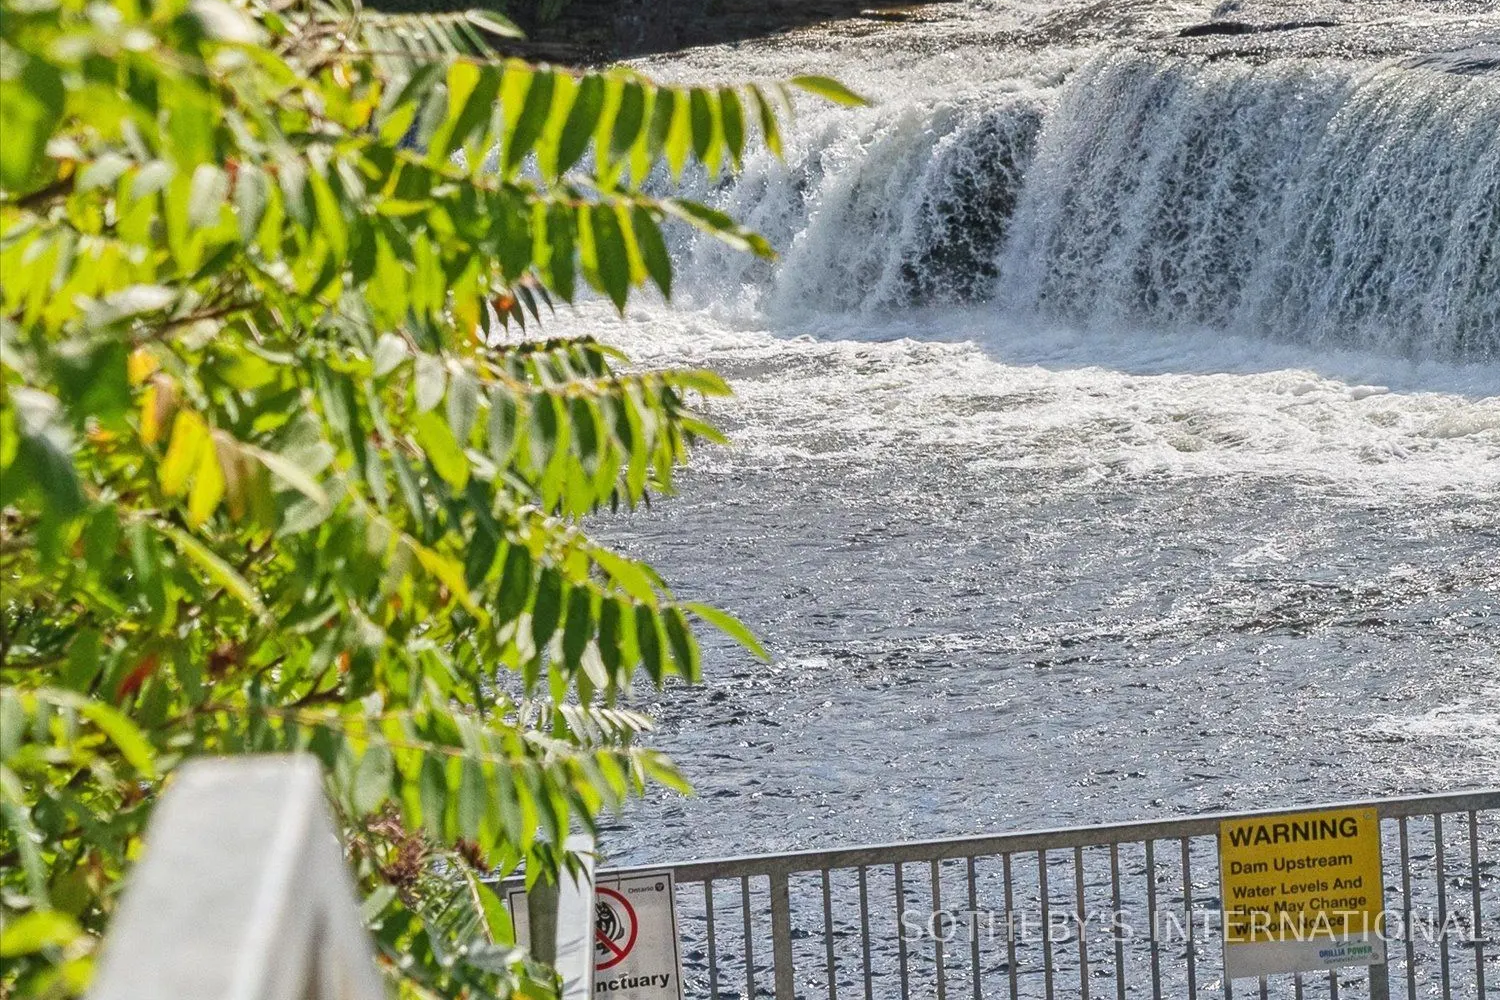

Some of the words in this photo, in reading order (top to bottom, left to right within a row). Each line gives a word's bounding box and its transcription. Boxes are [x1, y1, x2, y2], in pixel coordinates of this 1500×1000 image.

[1229, 816, 1359, 848] WARNING
[1230, 860, 1268, 875] Dam
[1273, 854, 1353, 874] Upstream
[628, 886, 654, 894] Ontario
[1232, 884, 1276, 899] Water
[1281, 879, 1328, 895] Levels
[1332, 876, 1363, 891] And
[1233, 903, 1269, 918] Flow
[1273, 900, 1305, 915] May
[1309, 896, 1367, 911] Change
[1347, 945, 1373, 955] POWER
[596, 973, 670, 993] nctuary
